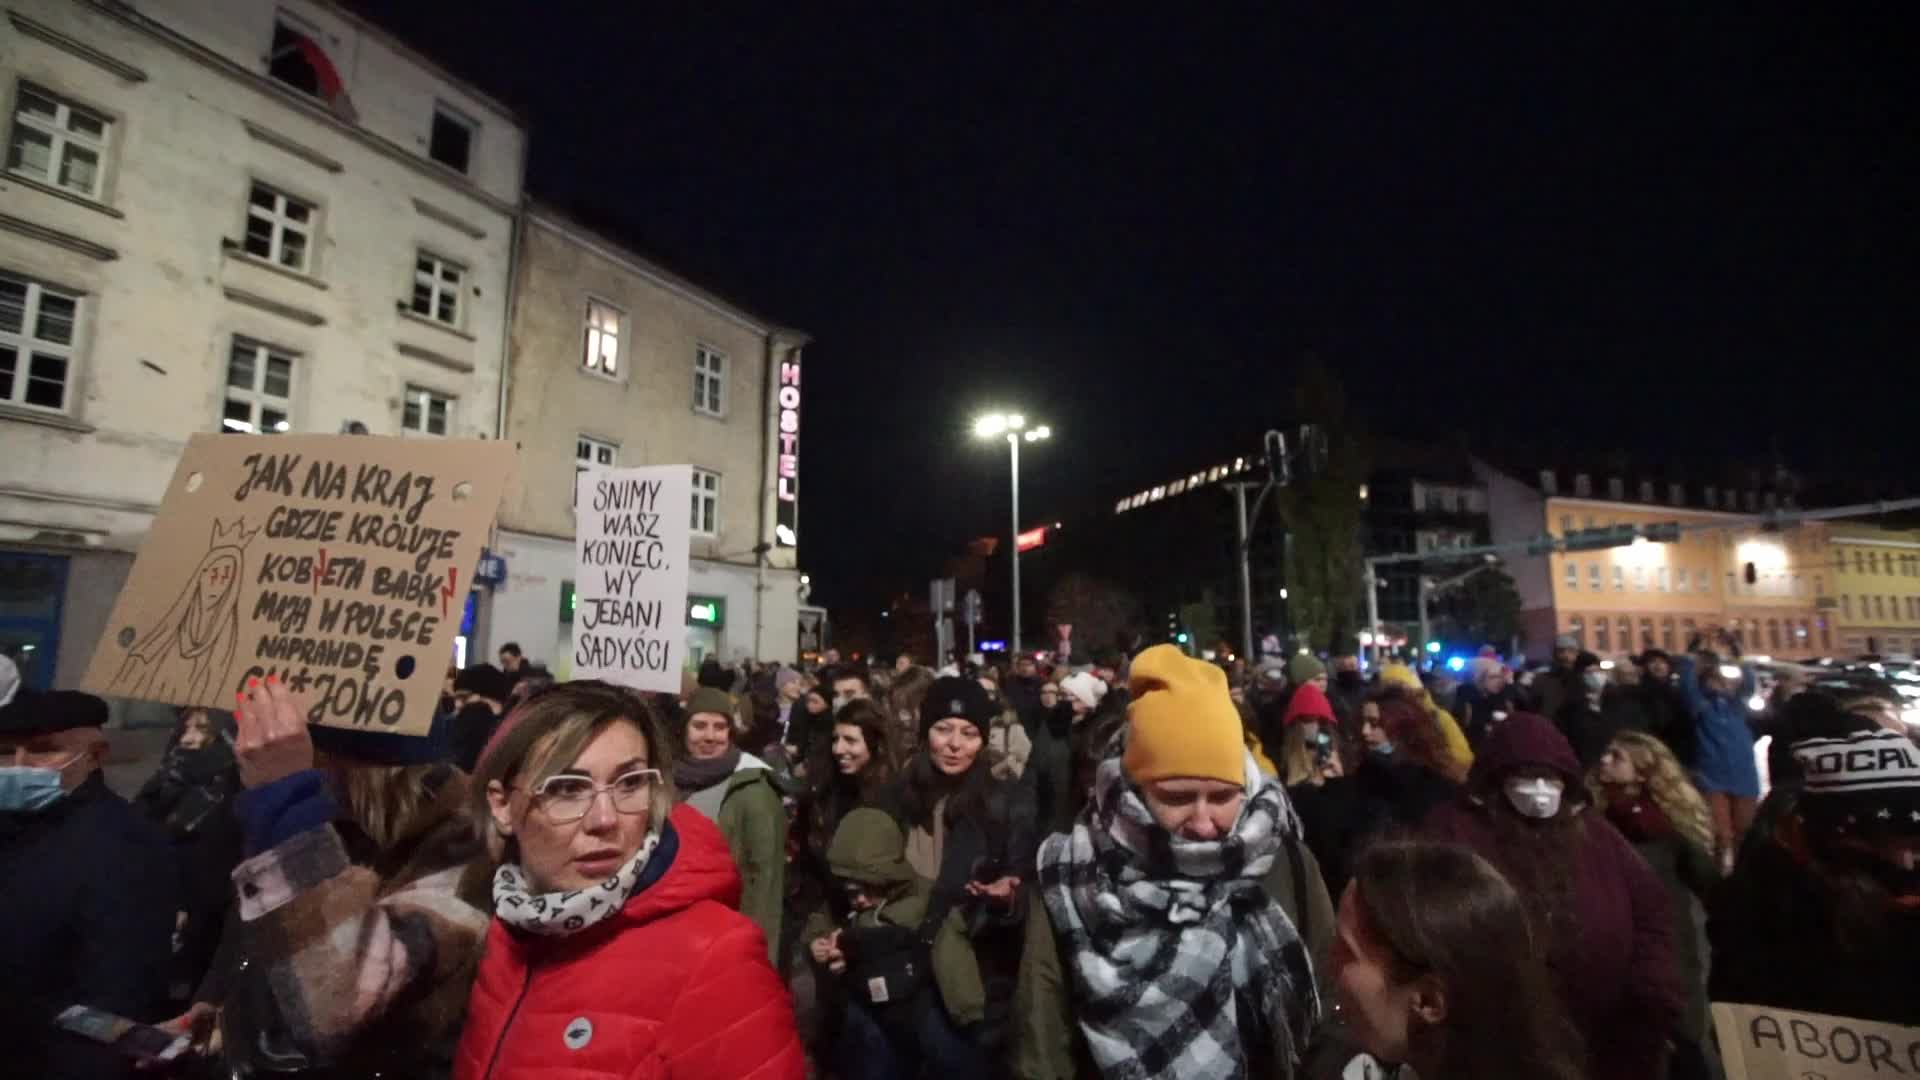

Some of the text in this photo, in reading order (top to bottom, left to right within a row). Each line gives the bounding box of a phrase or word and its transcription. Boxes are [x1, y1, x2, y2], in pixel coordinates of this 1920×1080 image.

[779, 362, 800, 501] HOSTEL
[235, 453, 435, 524] JAK NA KRAJ
[266, 505, 460, 573] GDZIE KRÓLUJE
[602, 512, 660, 539] WASZ
[605, 569, 642, 598] WY
[318, 599, 343, 632] W
[343, 601, 439, 645] POLSCE
[582, 598, 661, 629] JEBANI
[256, 634, 384, 681] NAPRAWDĘ
[576, 630, 669, 672] SADYŚCI
